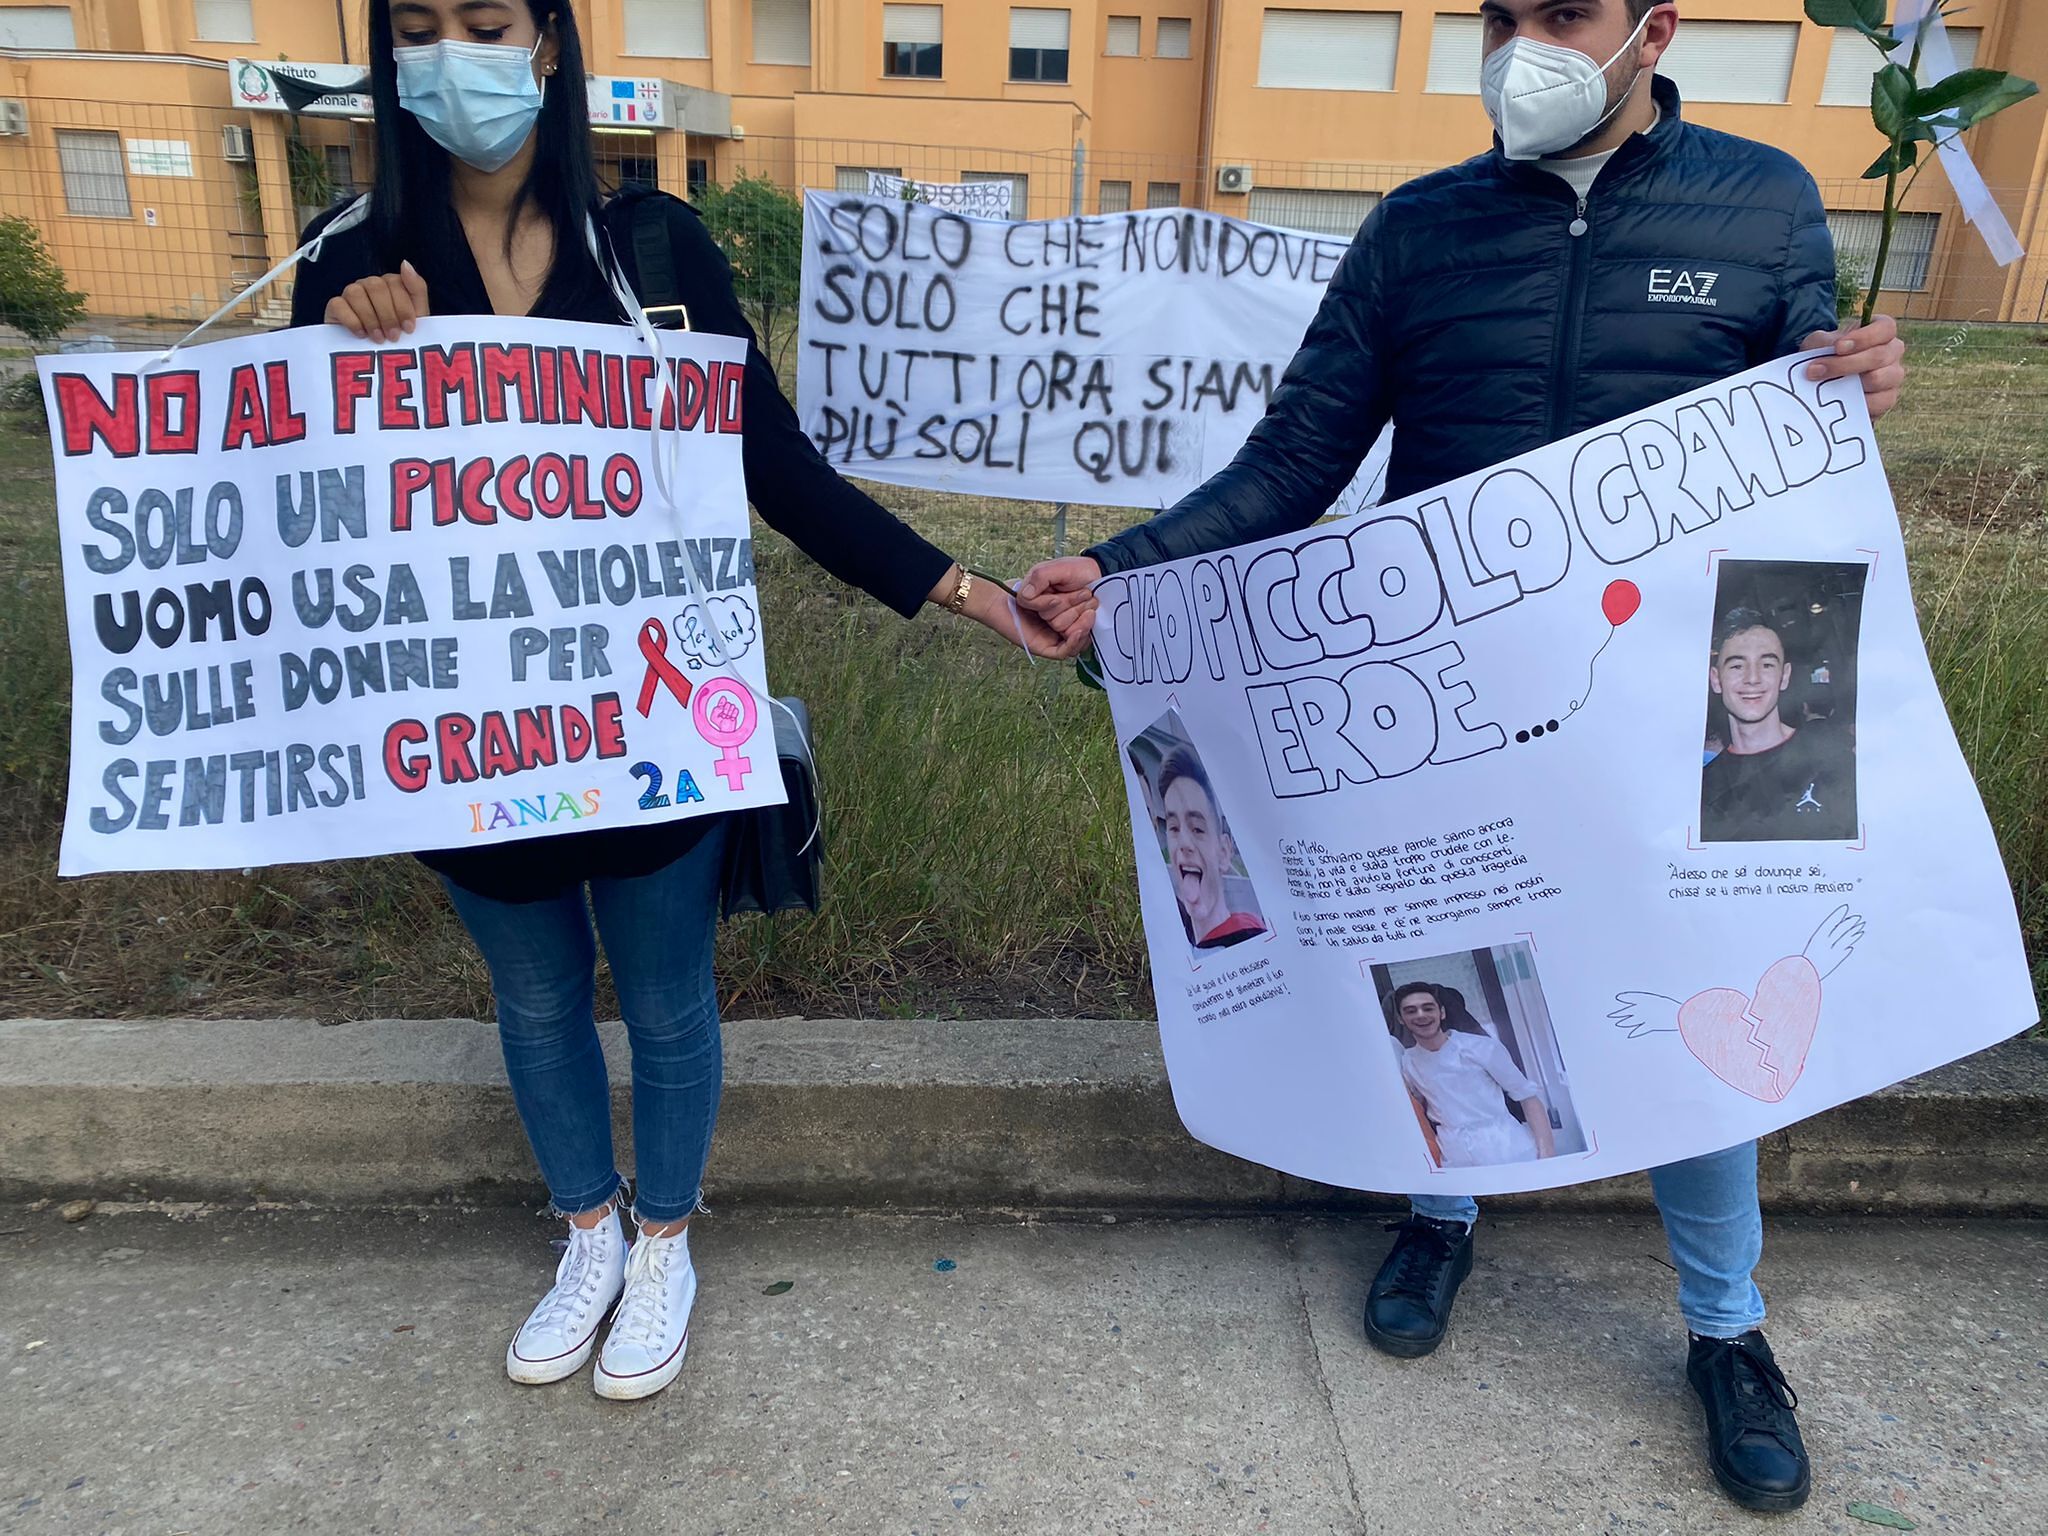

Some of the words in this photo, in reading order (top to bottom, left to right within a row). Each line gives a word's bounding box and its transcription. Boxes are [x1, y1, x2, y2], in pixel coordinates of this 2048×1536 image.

[819, 201, 971, 269] SOLO
[1004, 217, 1104, 269] CHE
[1122, 214, 1212, 274] NON
[1218, 221, 1350, 284] DOVE
[814, 264, 956, 333] SOLO
[999, 281, 1101, 336] CHE
[1647, 294, 1682, 303] EMPORIO
[1648, 268, 1719, 297] EA7
[52, 370, 200, 457] NO
[221, 360, 306, 451] AL
[330, 342, 745, 434] FEMMINICIDIO
[808, 340, 999, 404] TUTTI
[1017, 350, 1113, 415] ORA
[1142, 357, 1275, 413] SIAM
[813, 398, 907, 463] PIÙ
[914, 412, 1031, 474] SOLI
[81, 481, 243, 574] SOLO
[276, 465, 368, 548] UN
[390, 452, 643, 531] PICCOLO
[1090, 568, 1193, 685] CIAO
[1191, 469, 1571, 676] PICCOLO
[1570, 353, 1866, 565] GRANDE
[94, 577, 272, 654] UOMO
[292, 564, 428, 632] USA
[448, 553, 534, 620] LA
[537, 538, 756, 608] VIOLENZA
[685, 616, 706, 648] Per
[98, 660, 256, 745] SULLE
[280, 637, 459, 712] DONNE
[509, 624, 612, 681] PER
[90, 743, 366, 834] SENTIRSI
[383, 692, 627, 793] GRANDE
[468, 789, 602, 833] IANAS
[629, 761, 704, 810] 2A
[1329, 865, 1346, 876] vita
[1362, 859, 1388, 871] stata
[1393, 853, 1426, 867] troppo
[1431, 843, 1470, 859] crudele
[1474, 838, 1493, 851] con
[1367, 844, 1399, 861] queste
[1405, 836, 1437, 853] parole
[1443, 832, 1475, 844] siamo
[1478, 816, 1514, 835] ancora
[1352, 873, 1381, 886] avuto
[1396, 863, 1436, 880] fortuna
[1376, 878, 1415, 893] segnato
[1420, 876, 1437, 885] da
[1440, 867, 1476, 884] questa
[1481, 854, 1528, 874] tragedia
[1705, 887, 1717, 897] se
[1766, 884, 1773, 895] il
[1777, 883, 1809, 895] nostro
[1711, 868, 1729, 879] che
[1734, 865, 1747, 878] sei
[1754, 865, 1802, 881] dovunque
[1405, 898, 1438, 911] sempre
[1443, 889, 1487, 905] impresso
[1425, 907, 1480, 923] accorgiamo
[1487, 896, 1523, 912] sempre
[1527, 887, 1562, 901] troppo
[1371, 934, 1384, 943] da
